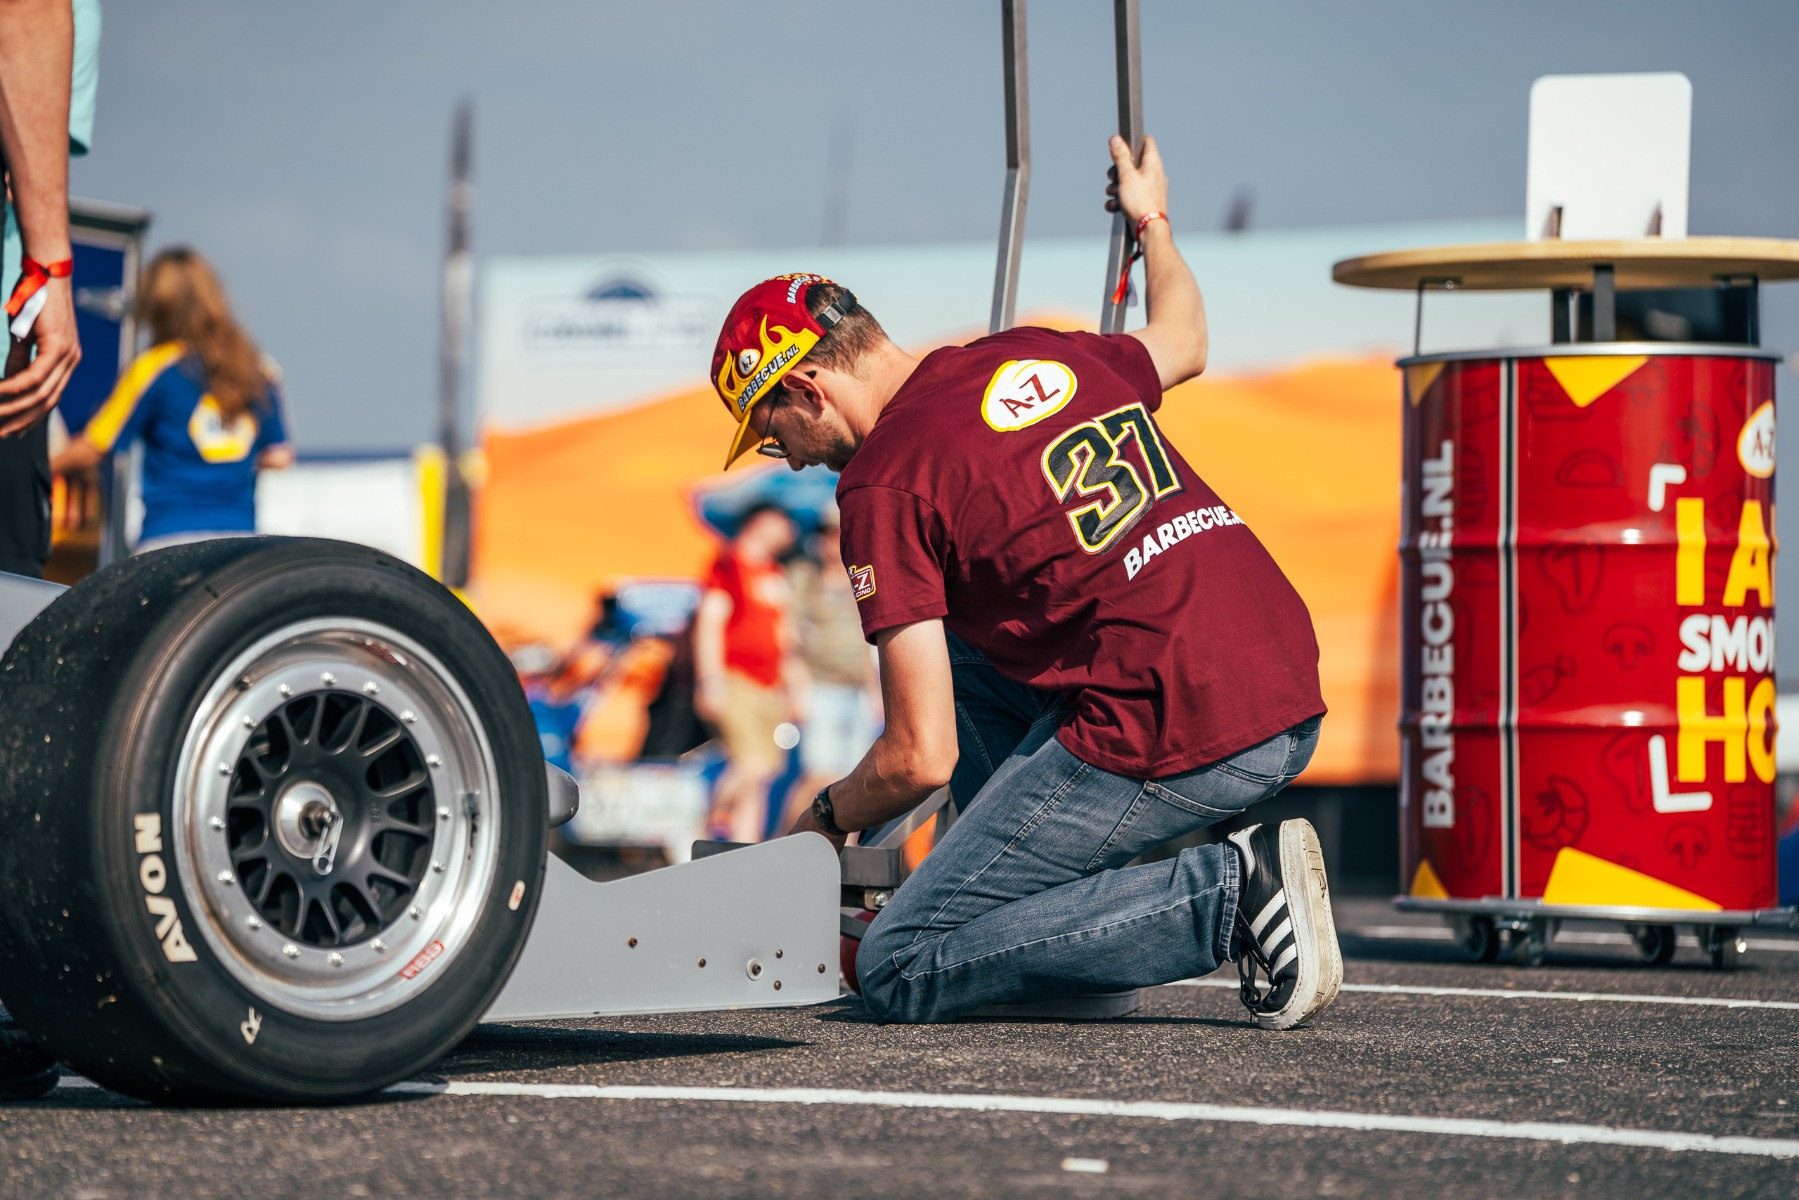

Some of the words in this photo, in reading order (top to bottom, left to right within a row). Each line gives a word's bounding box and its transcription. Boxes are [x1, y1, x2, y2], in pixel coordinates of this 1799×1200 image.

[738, 344, 800, 413] BARBECUE.NL
[999, 374, 1061, 418] A-Z
[1040, 402, 1186, 555] 37
[1123, 505, 1246, 581] BARBECUE.N
[1676, 497, 1706, 606] I
[1722, 499, 1778, 608] A
[1421, 440, 1455, 828] BARBECUE.NL
[134, 812, 198, 962] AVON
